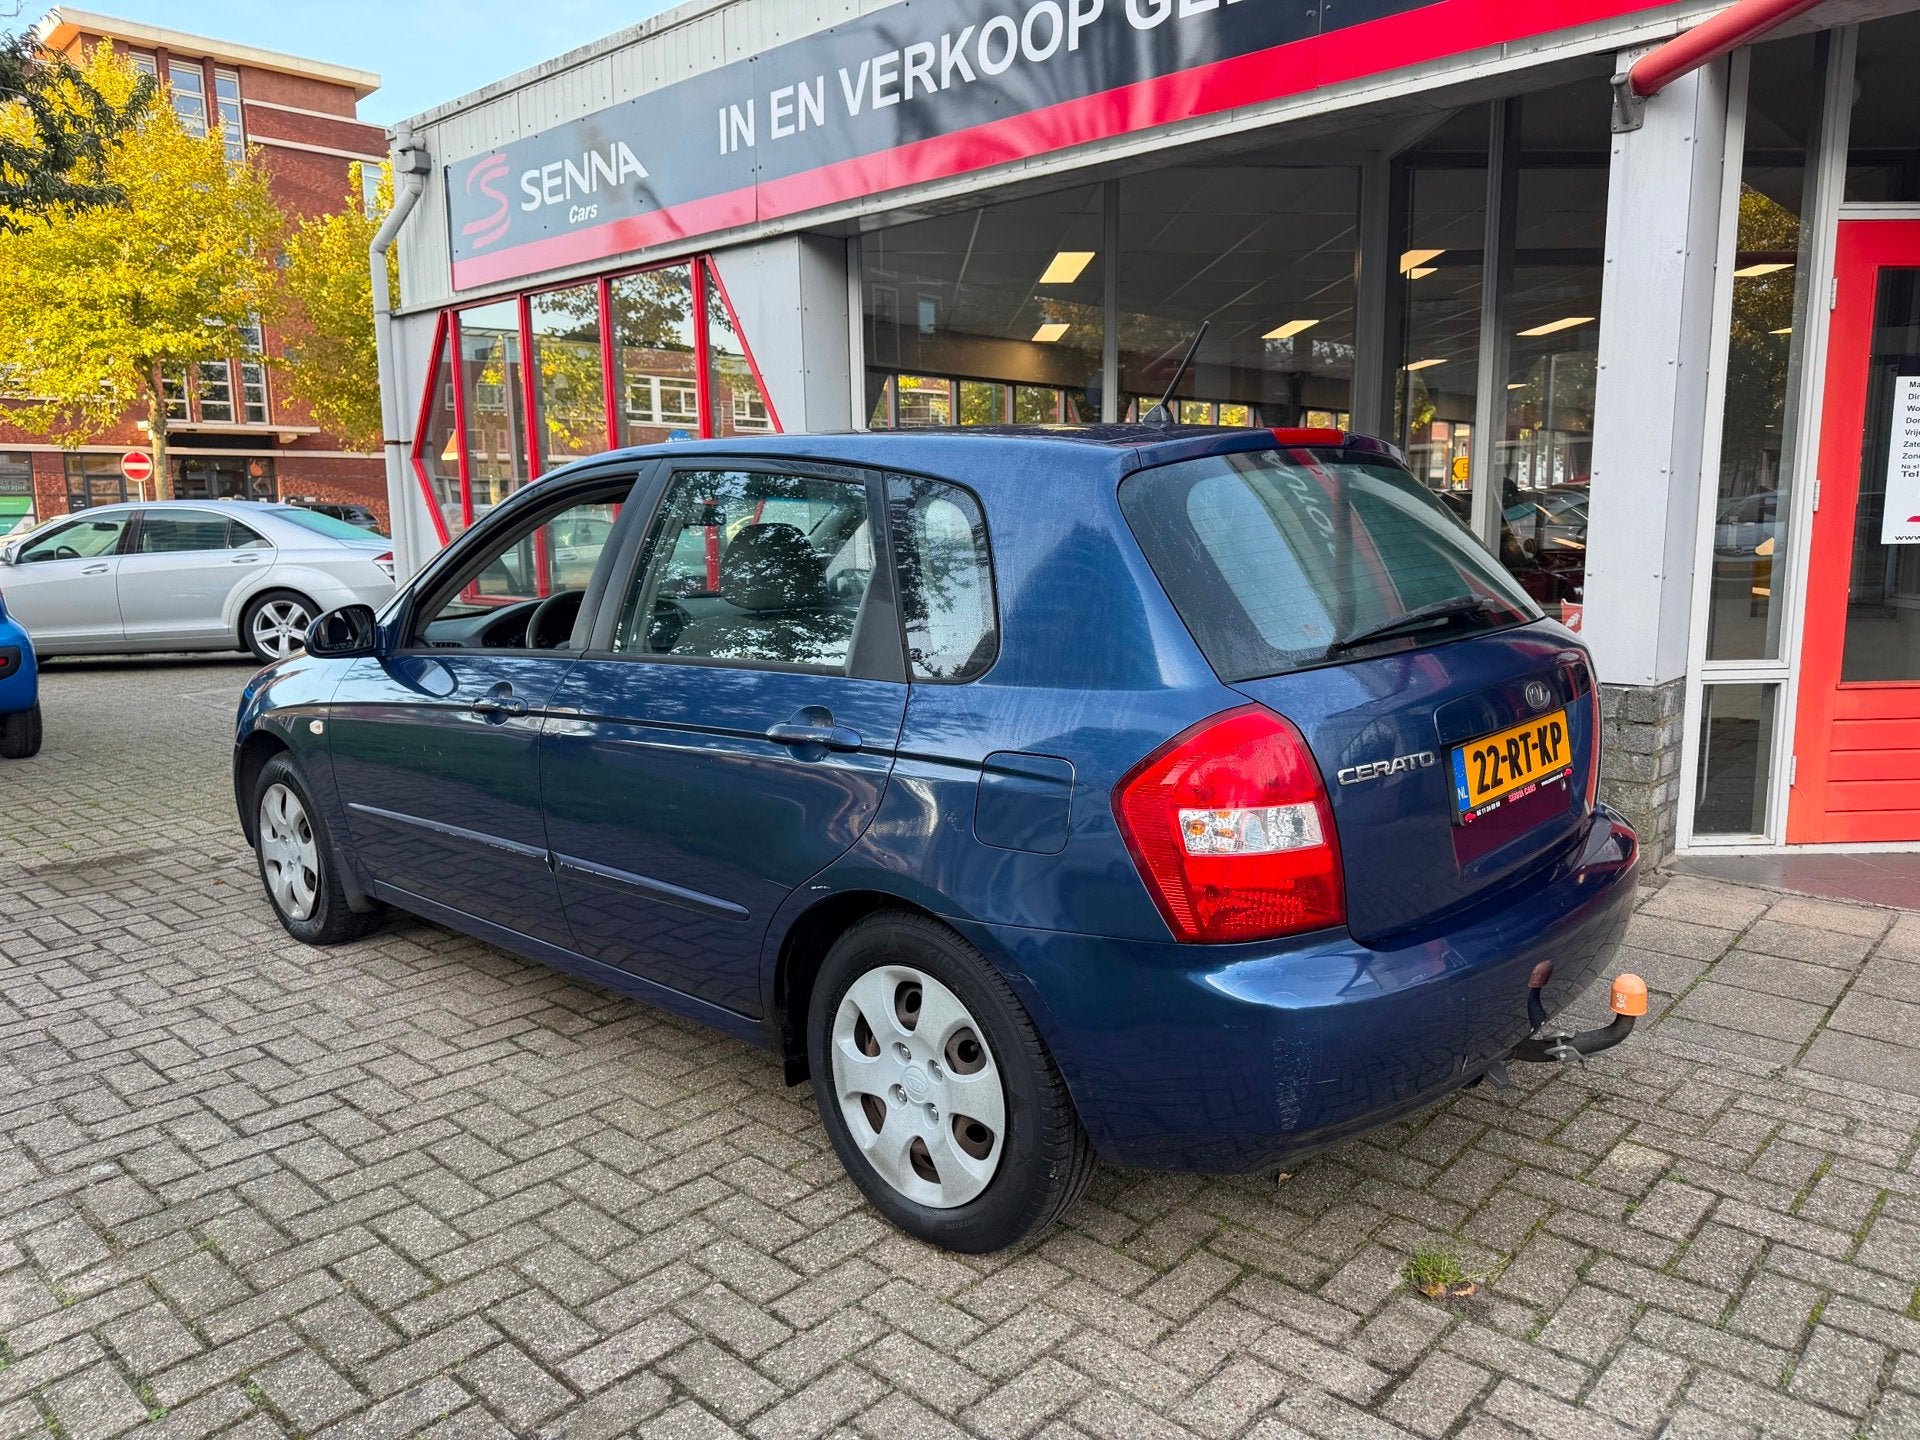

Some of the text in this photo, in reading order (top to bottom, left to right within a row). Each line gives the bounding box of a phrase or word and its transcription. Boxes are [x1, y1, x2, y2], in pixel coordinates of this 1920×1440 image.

[718, 98, 755, 155] IN
[770, 75, 825, 141] EN
[838, 0, 1106, 118] VERKOOP
[520, 141, 650, 212] SENNA
[568, 203, 598, 224] Cars
[1337, 750, 1435, 786] CERATO
[1473, 721, 1563, 796] 22-RT-KP
[1457, 785, 1468, 801] NL
